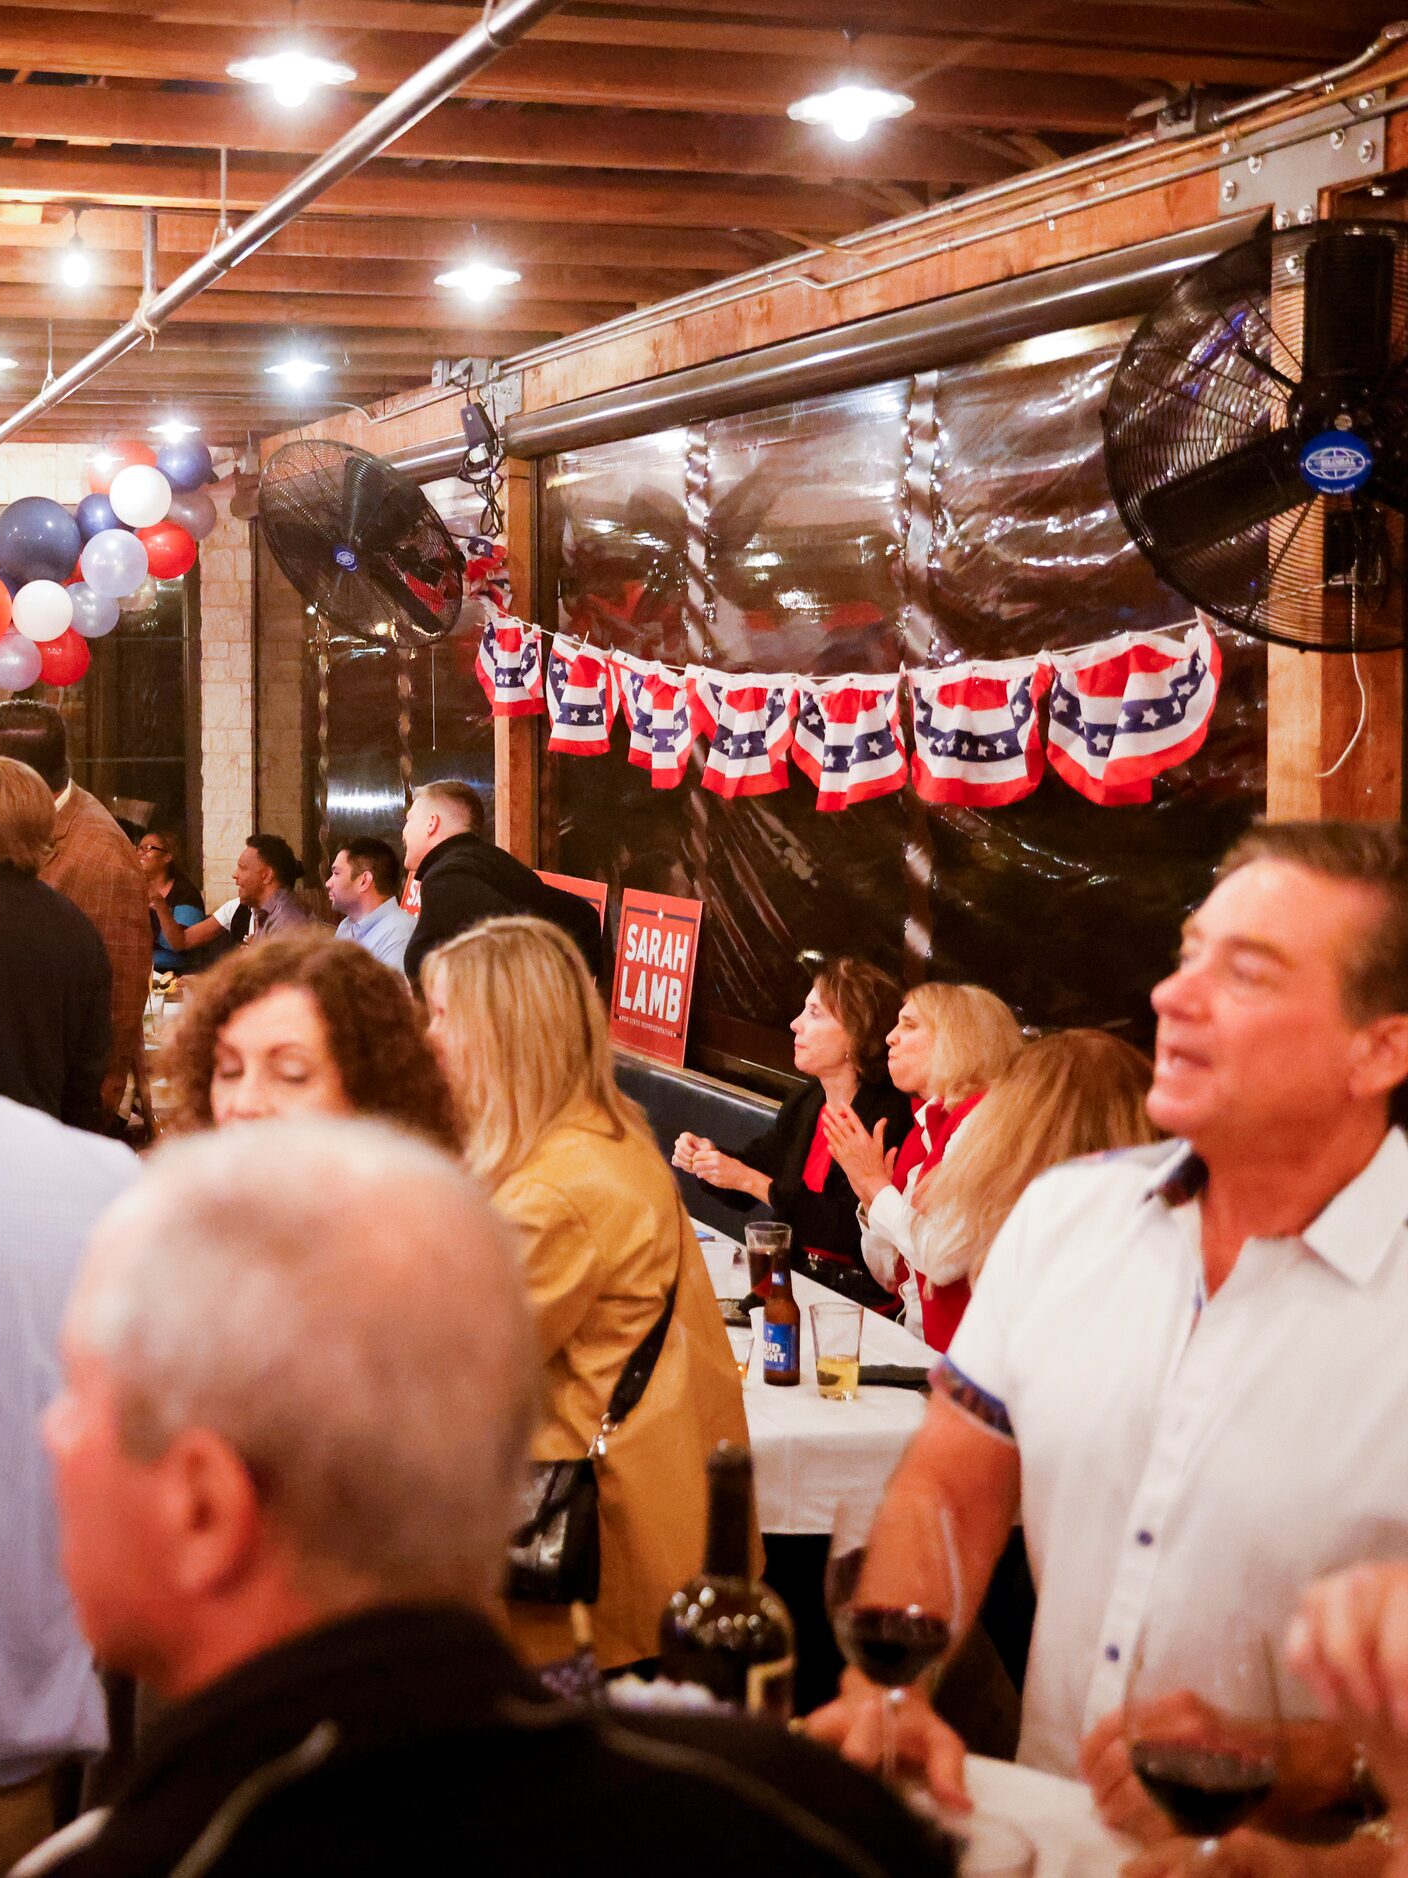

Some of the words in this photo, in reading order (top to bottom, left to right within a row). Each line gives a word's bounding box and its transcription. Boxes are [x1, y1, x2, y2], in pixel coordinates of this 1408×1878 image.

[625, 924, 689, 973] SARAH
[620, 966, 682, 1023] LAMB
[629, 1018, 641, 1027] STATE
[640, 1021, 674, 1038] REPRESENTATIVE
[763, 1342, 781, 1352] UD
